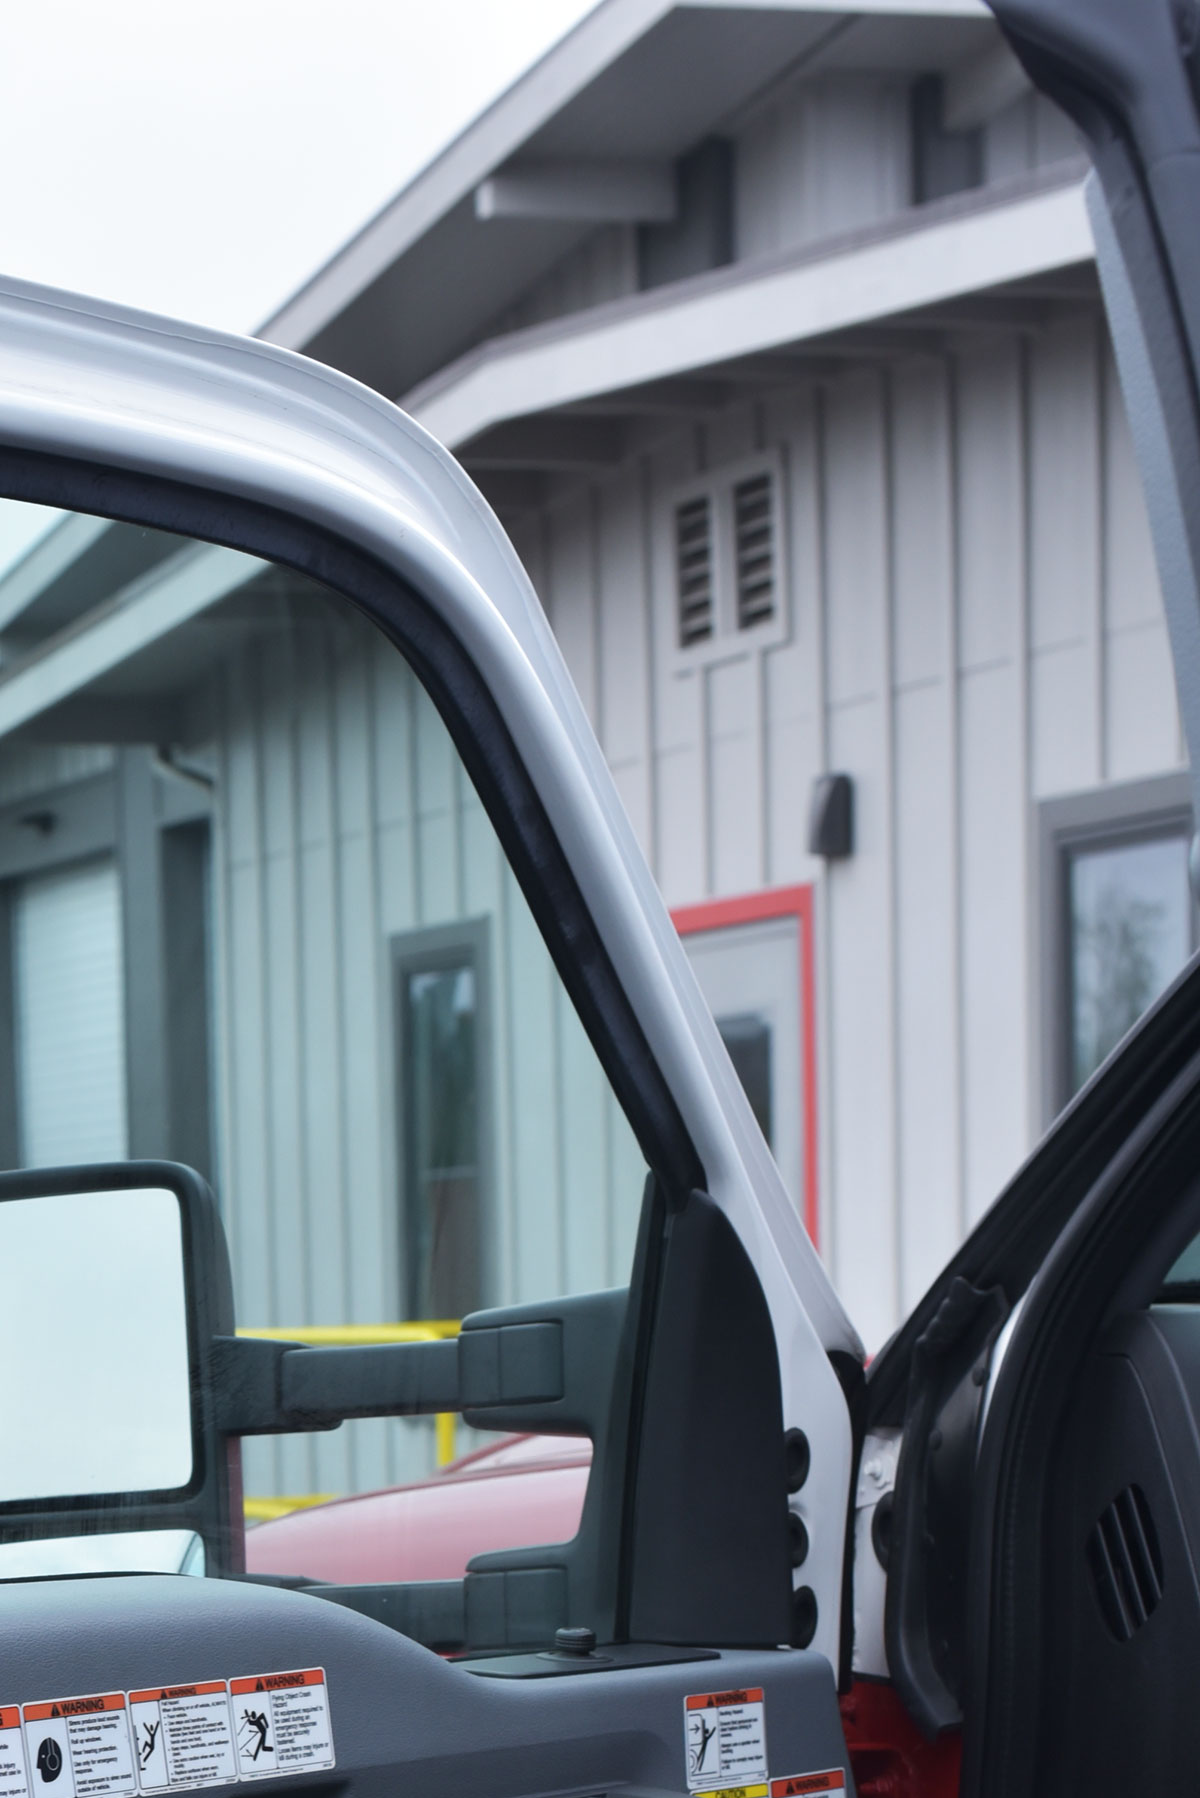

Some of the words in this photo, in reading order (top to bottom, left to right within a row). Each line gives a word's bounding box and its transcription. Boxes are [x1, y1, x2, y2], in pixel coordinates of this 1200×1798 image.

[265, 1674, 304, 1687] WARNING
[715, 1692, 747, 1704] WARNING
[60, 1698, 104, 1713] WARNING
[795, 1776, 829, 1790] WARNING
